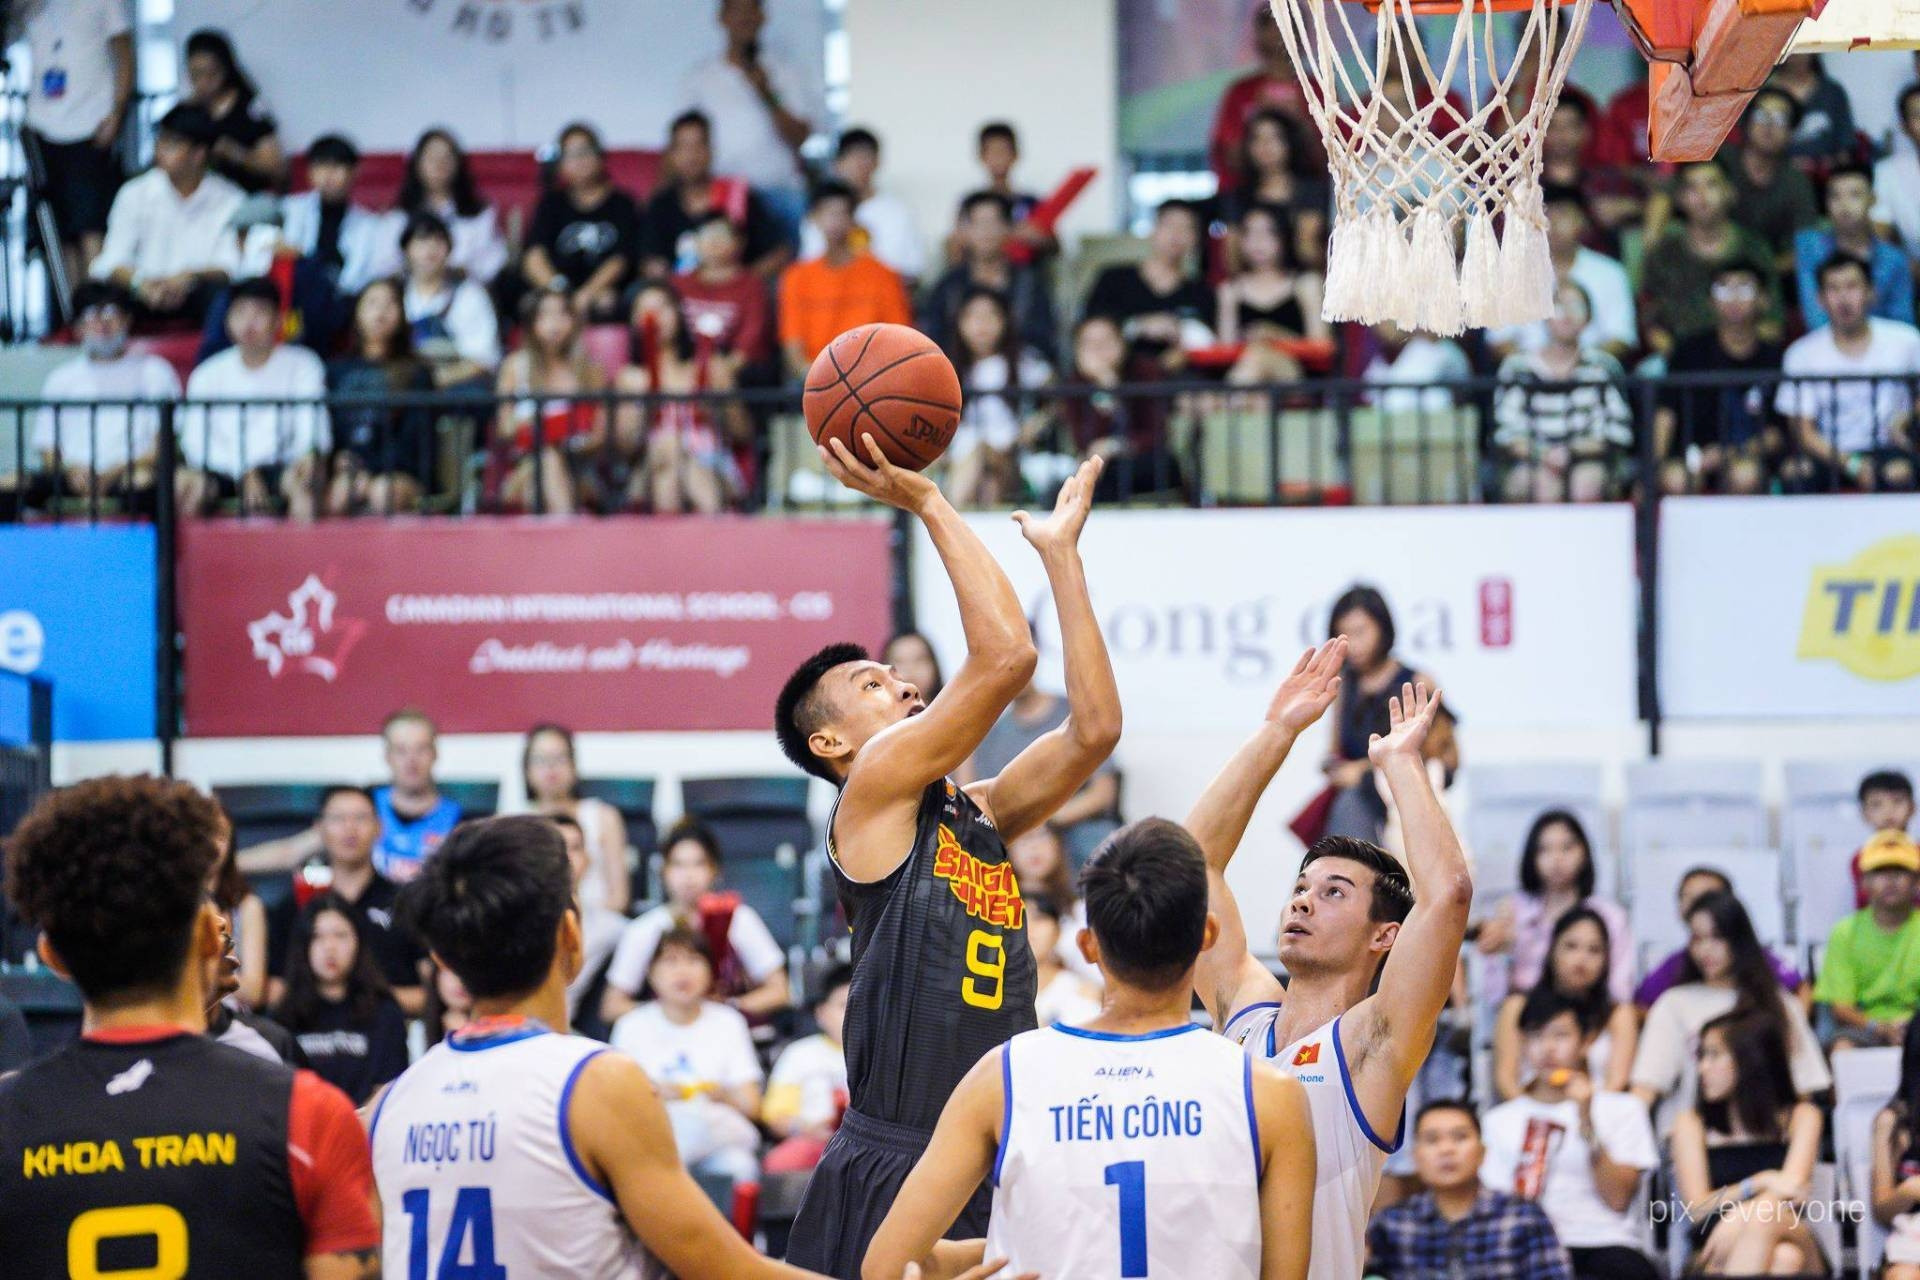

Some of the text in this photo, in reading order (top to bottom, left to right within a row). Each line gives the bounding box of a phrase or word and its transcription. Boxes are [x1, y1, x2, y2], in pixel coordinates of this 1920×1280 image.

[961, 929, 1006, 1010] 9
[1296, 1074, 1325, 1083] hone
[403, 1112, 496, 1171] NGỌC TÚ
[1049, 1094, 1202, 1142] TIẾN CÔNG
[23, 1132, 237, 1179] KHOA TRAN
[402, 1187, 507, 1280] 14
[1104, 1160, 1148, 1278] 1
